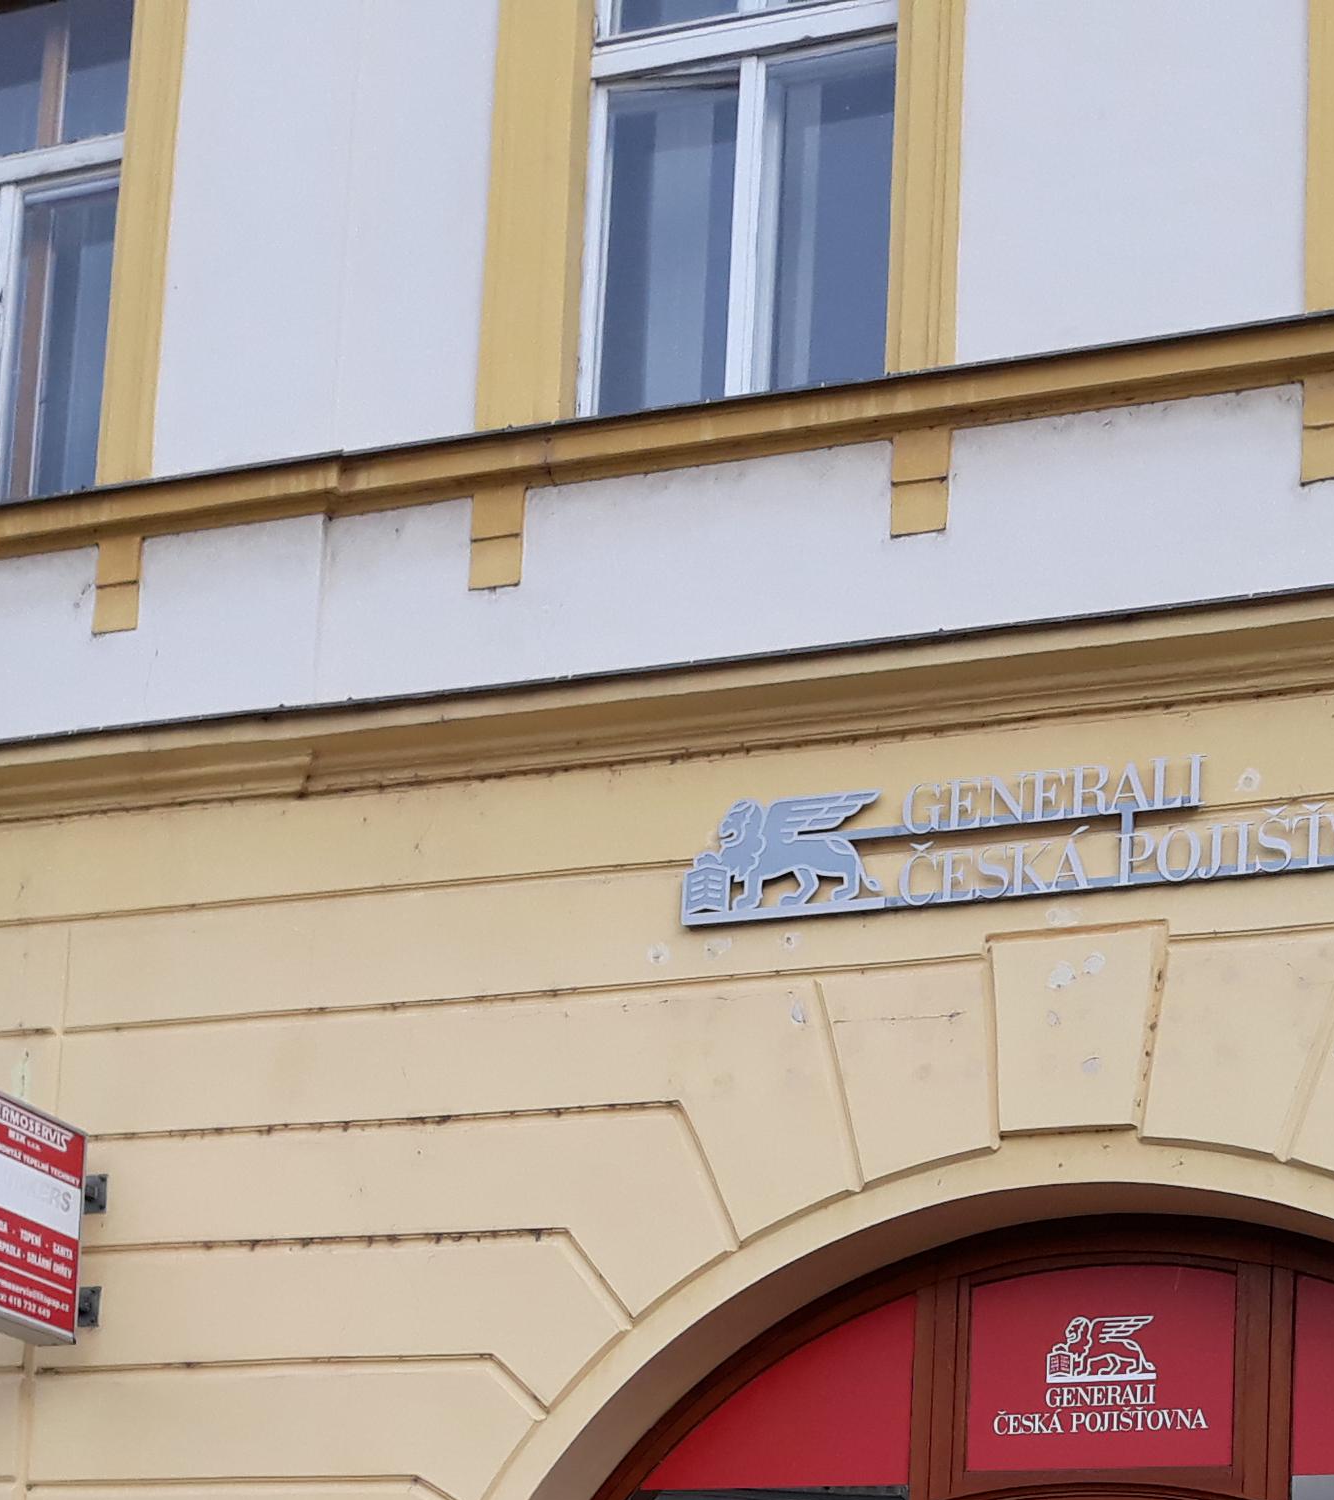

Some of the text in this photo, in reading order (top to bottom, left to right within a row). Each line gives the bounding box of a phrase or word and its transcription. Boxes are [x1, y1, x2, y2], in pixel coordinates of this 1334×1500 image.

[901, 753, 1208, 835] GENERALI
[899, 825, 1089, 907] ČESKÁ
[993, 1406, 1209, 1435] ČESKÁ POJIŠŤOVNA
[1045, 1383, 1156, 1407] GENERALI
